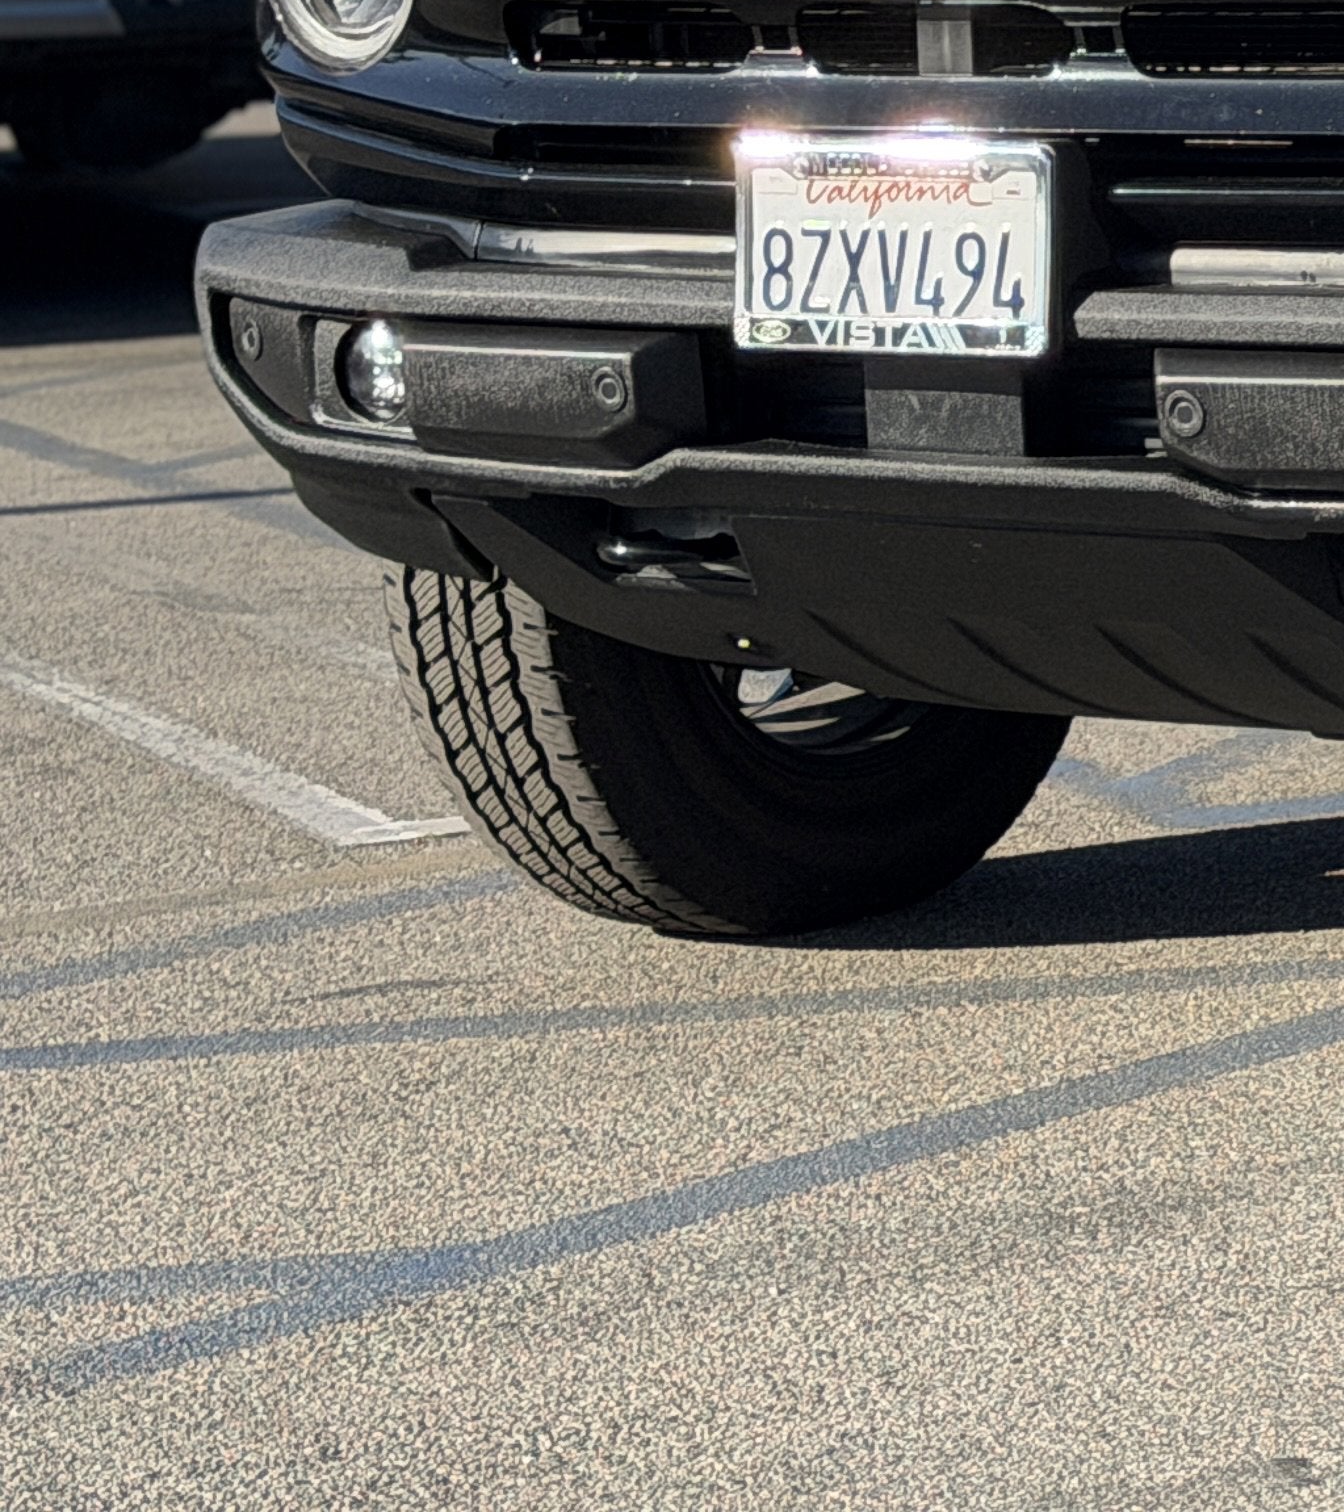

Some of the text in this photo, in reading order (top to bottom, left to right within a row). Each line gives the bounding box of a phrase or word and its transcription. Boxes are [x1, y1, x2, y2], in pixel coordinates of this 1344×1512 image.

[806, 178, 993, 219] California
[762, 221, 1025, 318] 8ZXV494
[806, 318, 944, 348] VISTA
